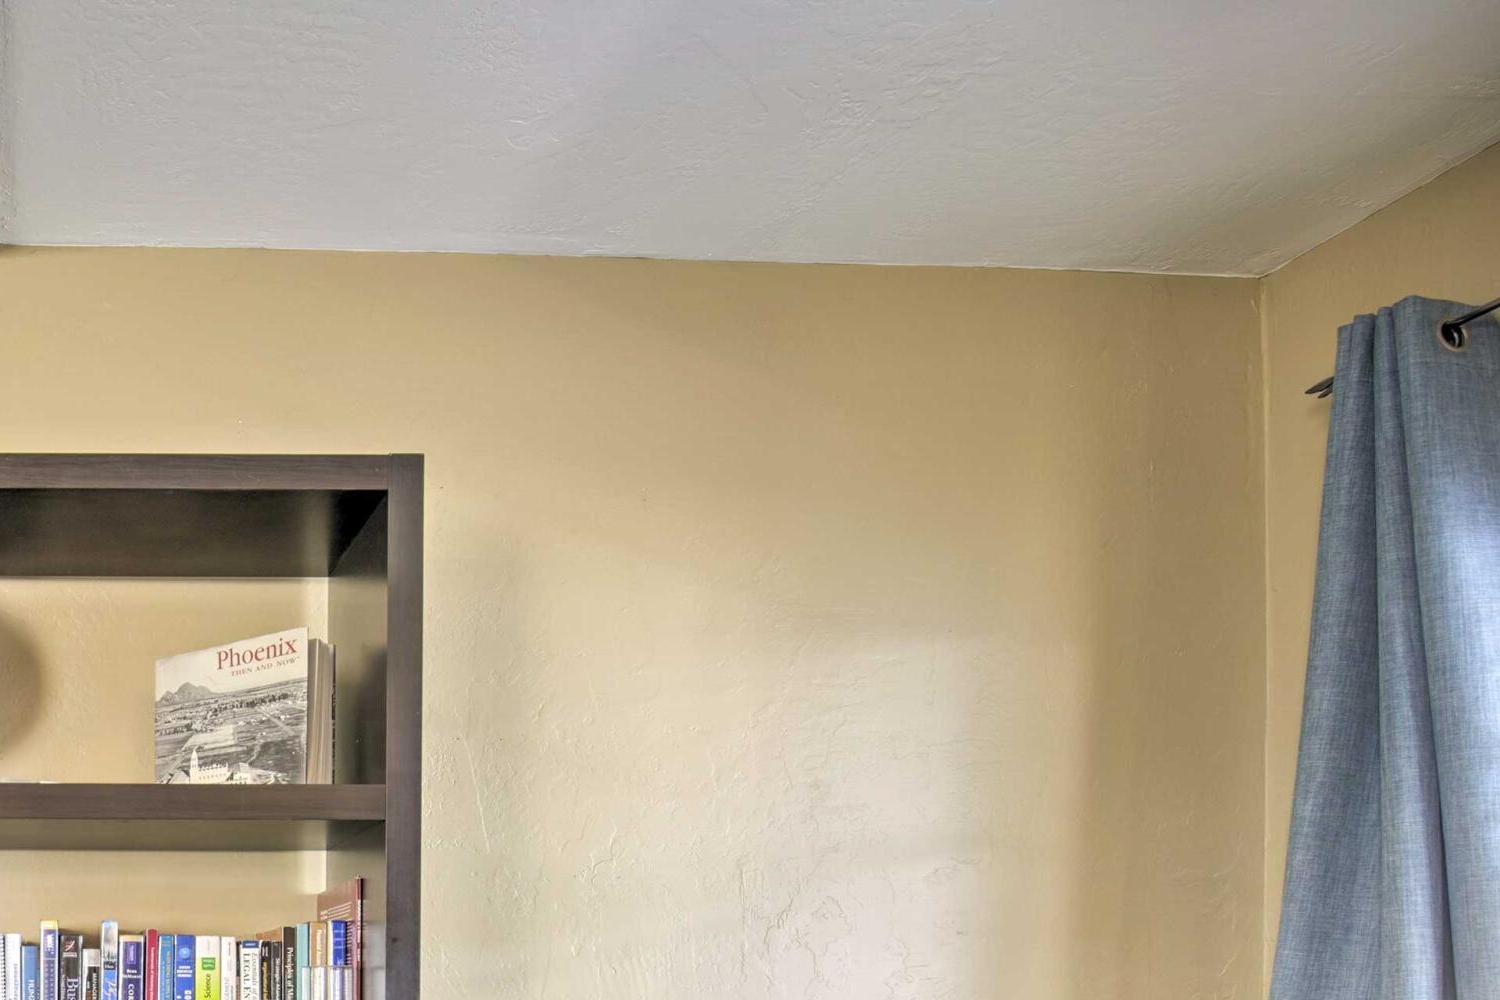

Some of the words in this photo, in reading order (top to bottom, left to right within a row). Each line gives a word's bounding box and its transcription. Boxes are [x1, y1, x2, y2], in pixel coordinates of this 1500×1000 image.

[217, 638, 298, 670] Phoenix
[231, 668, 252, 677] THEN
[257, 662, 273, 671] AND
[277, 657, 296, 667] NOW
[286, 947, 294, 978] Principles
